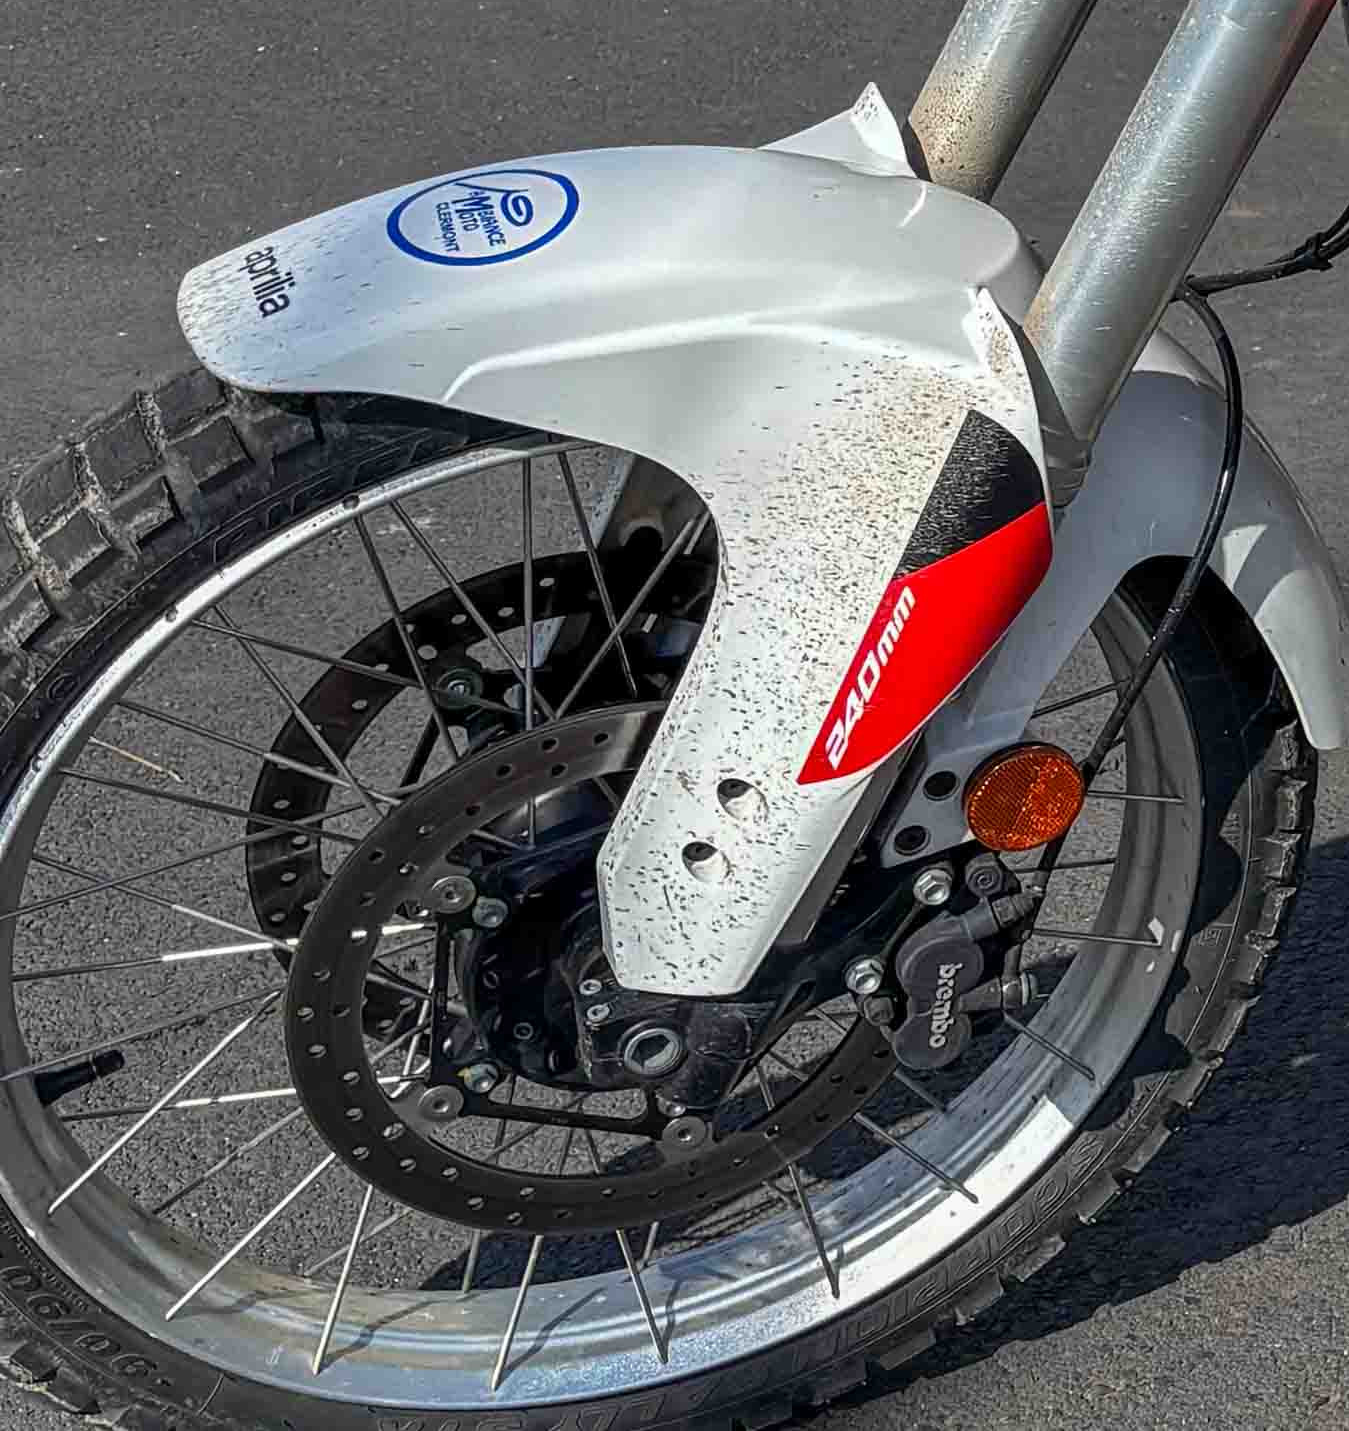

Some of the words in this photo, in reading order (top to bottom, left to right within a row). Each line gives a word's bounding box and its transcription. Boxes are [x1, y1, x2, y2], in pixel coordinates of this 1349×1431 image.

[435, 201, 460, 253] CLERMONT
[237, 246, 297, 319] aprilia
[824, 585, 918, 771] 240mm
[928, 962, 964, 1049] brembo
